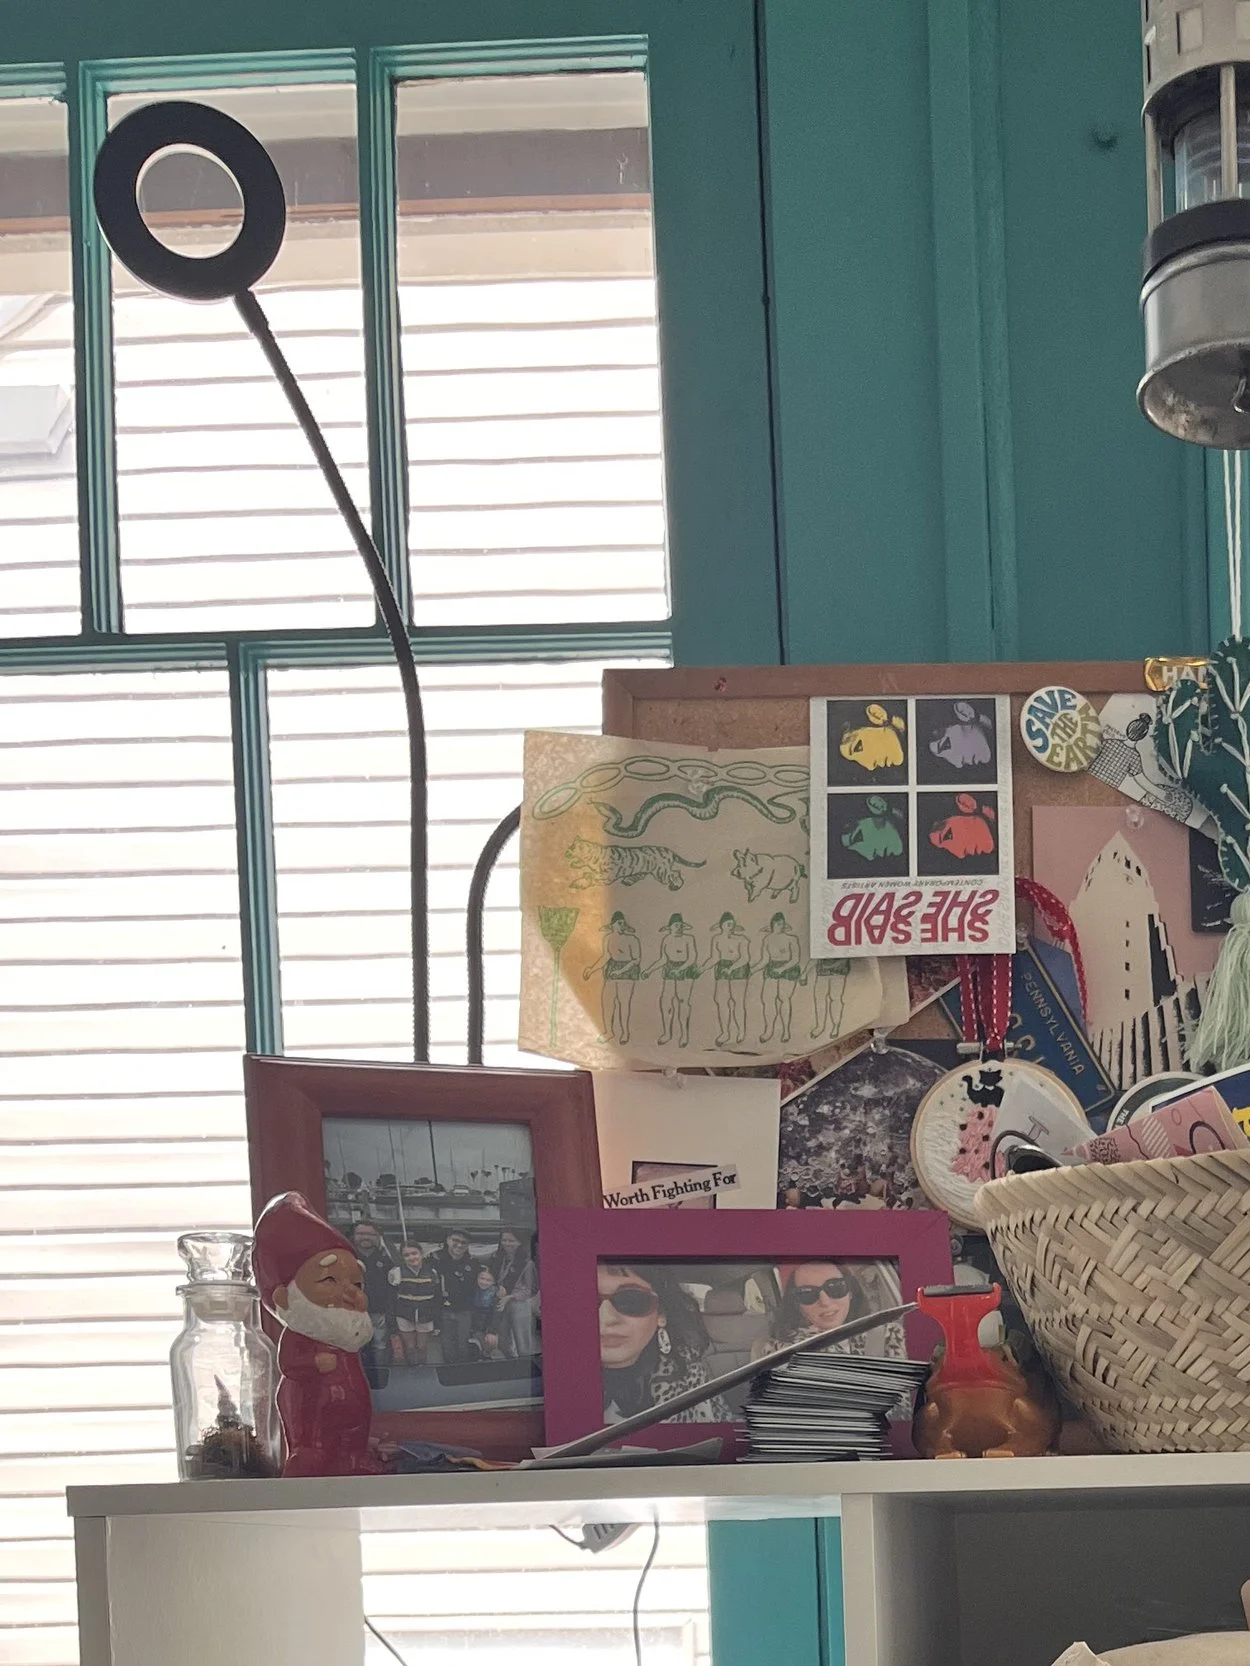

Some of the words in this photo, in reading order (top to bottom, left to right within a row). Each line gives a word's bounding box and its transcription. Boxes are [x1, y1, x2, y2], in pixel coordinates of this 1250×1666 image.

[1026, 690, 1078, 754] SAVE
[1051, 713, 1078, 743] THE
[840, 880, 875, 890] ARTISTS
[877, 880, 912, 888] WOMEN
[912, 878, 984, 888] CONTEMPORARY
[1021, 972, 1085, 1076] PENNSYLVANIA
[603, 1188, 650, 1209] Worth
[651, 1179, 711, 1200] Fighting
[712, 1171, 737, 1187] For
